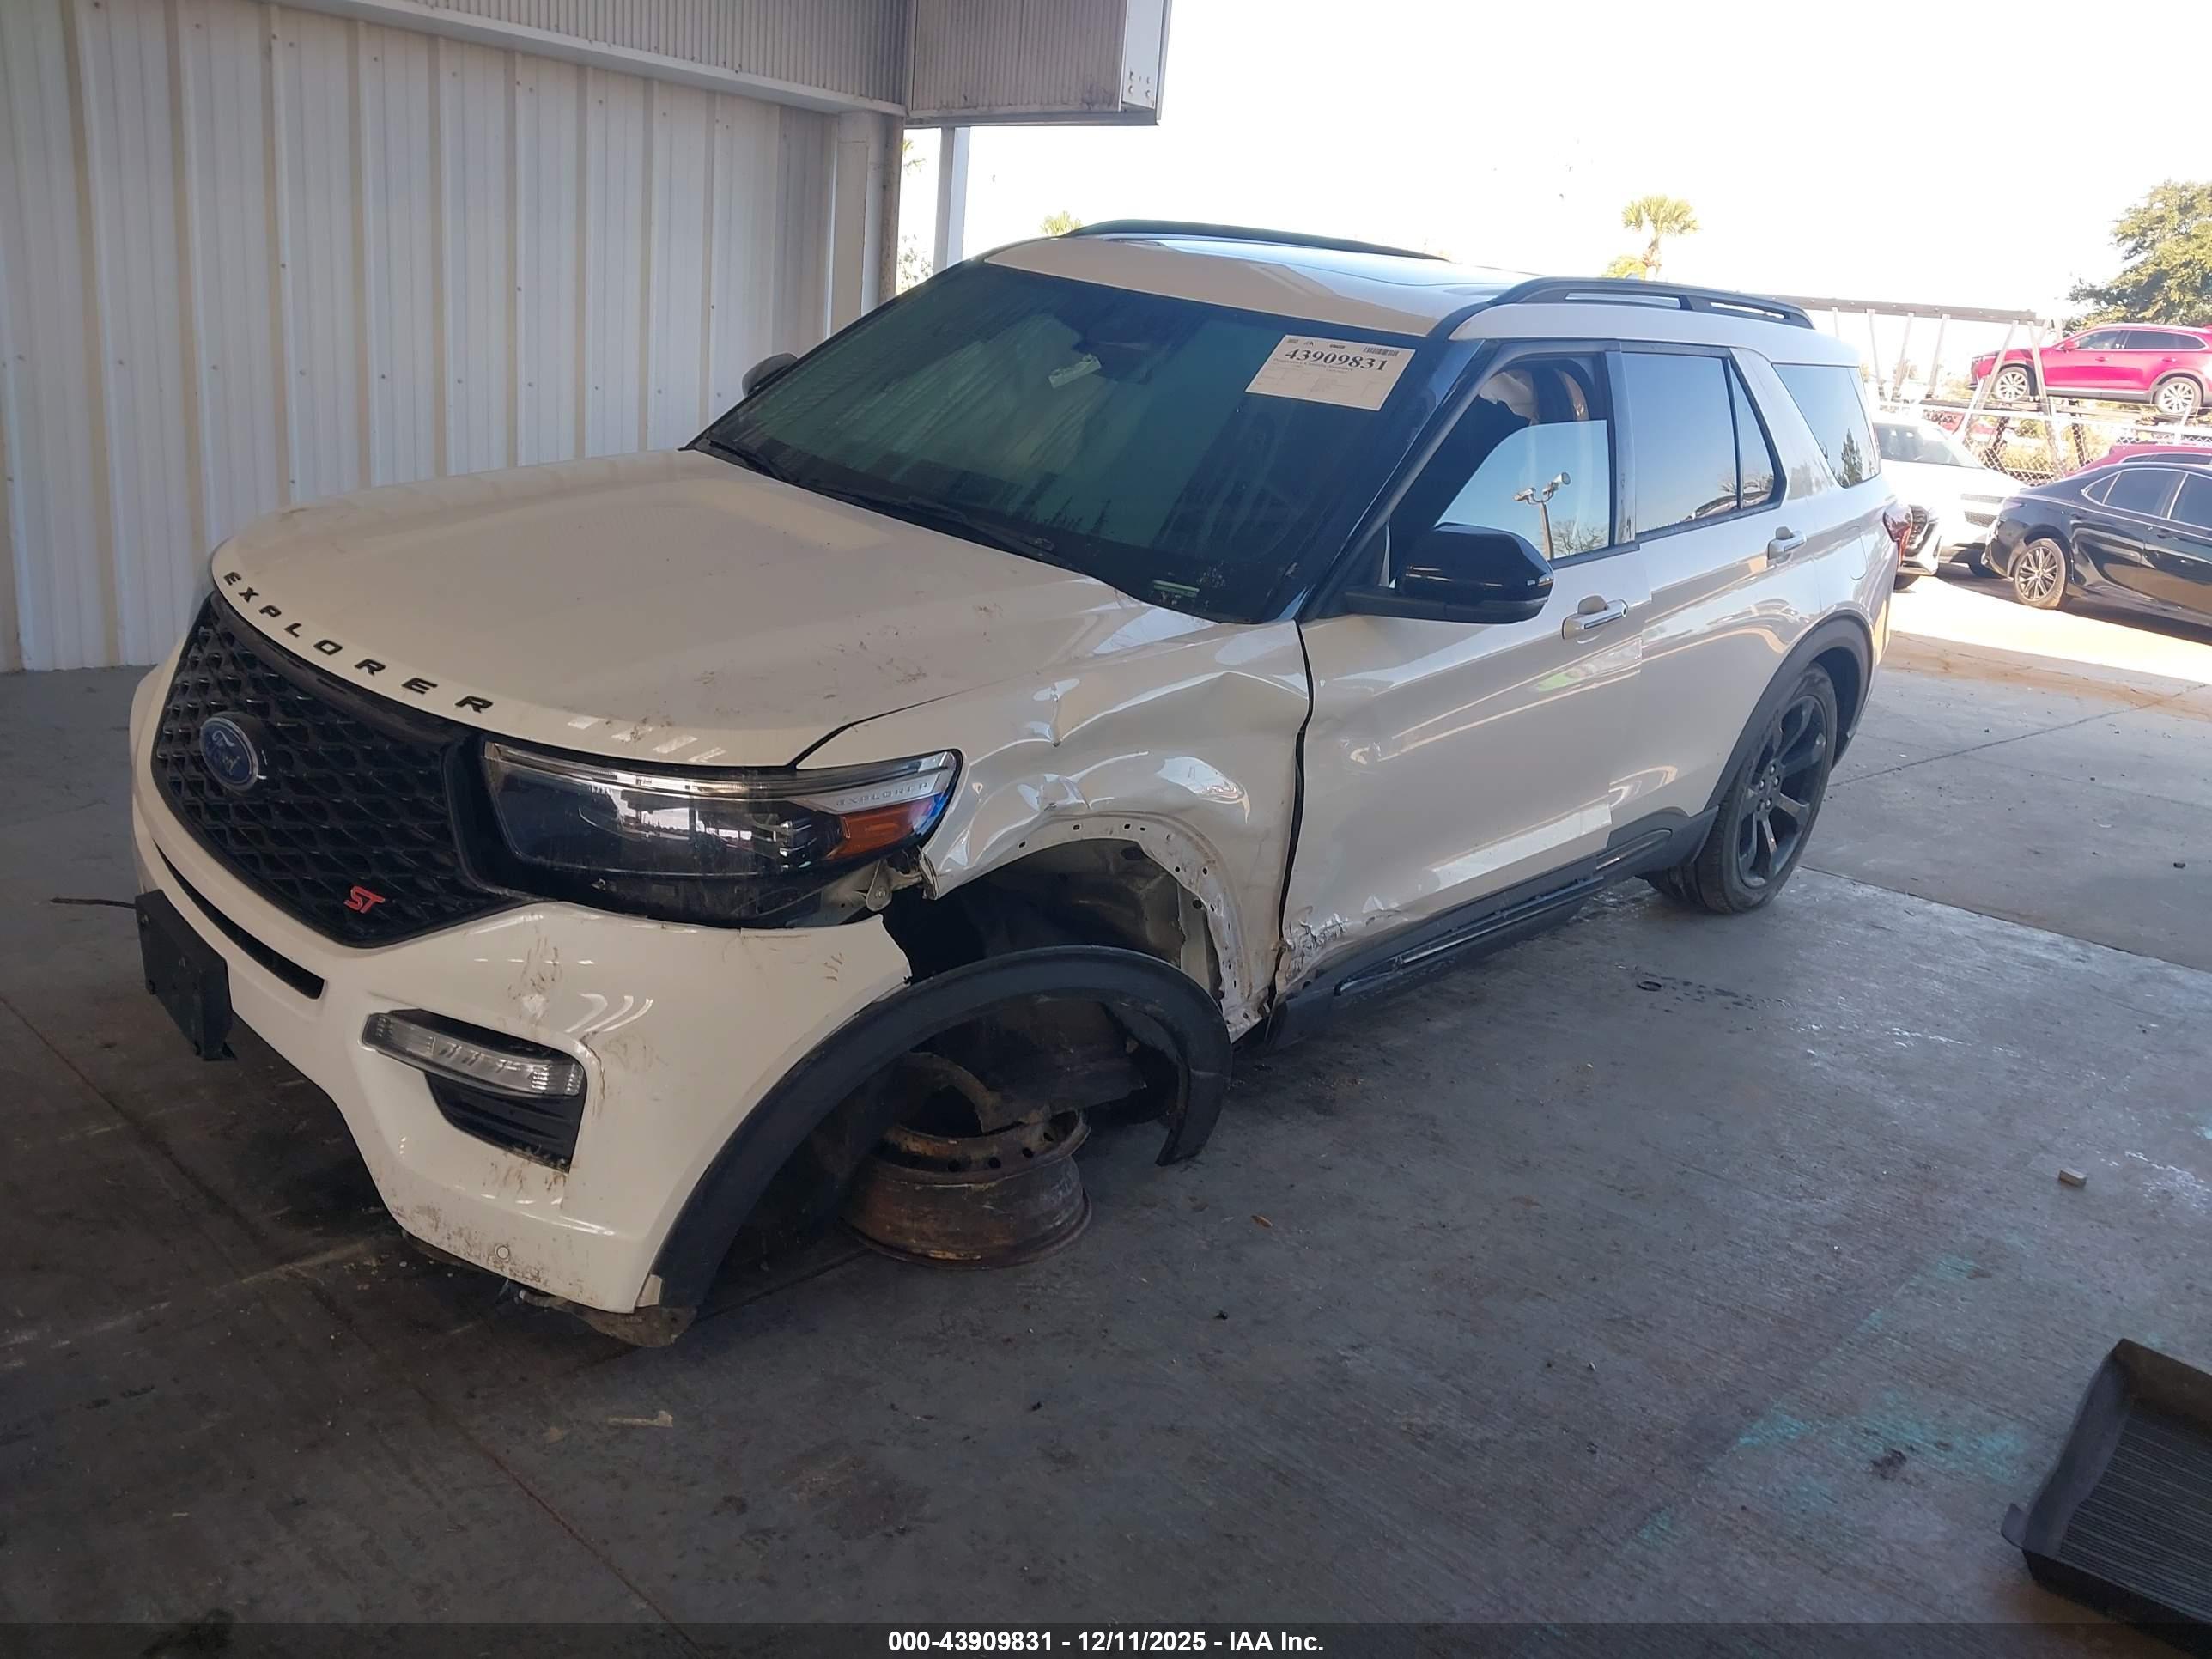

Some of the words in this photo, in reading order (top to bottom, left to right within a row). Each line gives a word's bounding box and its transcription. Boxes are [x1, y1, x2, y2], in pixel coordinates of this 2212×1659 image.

[1285, 349, 1388, 371] 43909831
[223, 571, 494, 714] EXPLORER
[343, 885, 386, 914] ST
